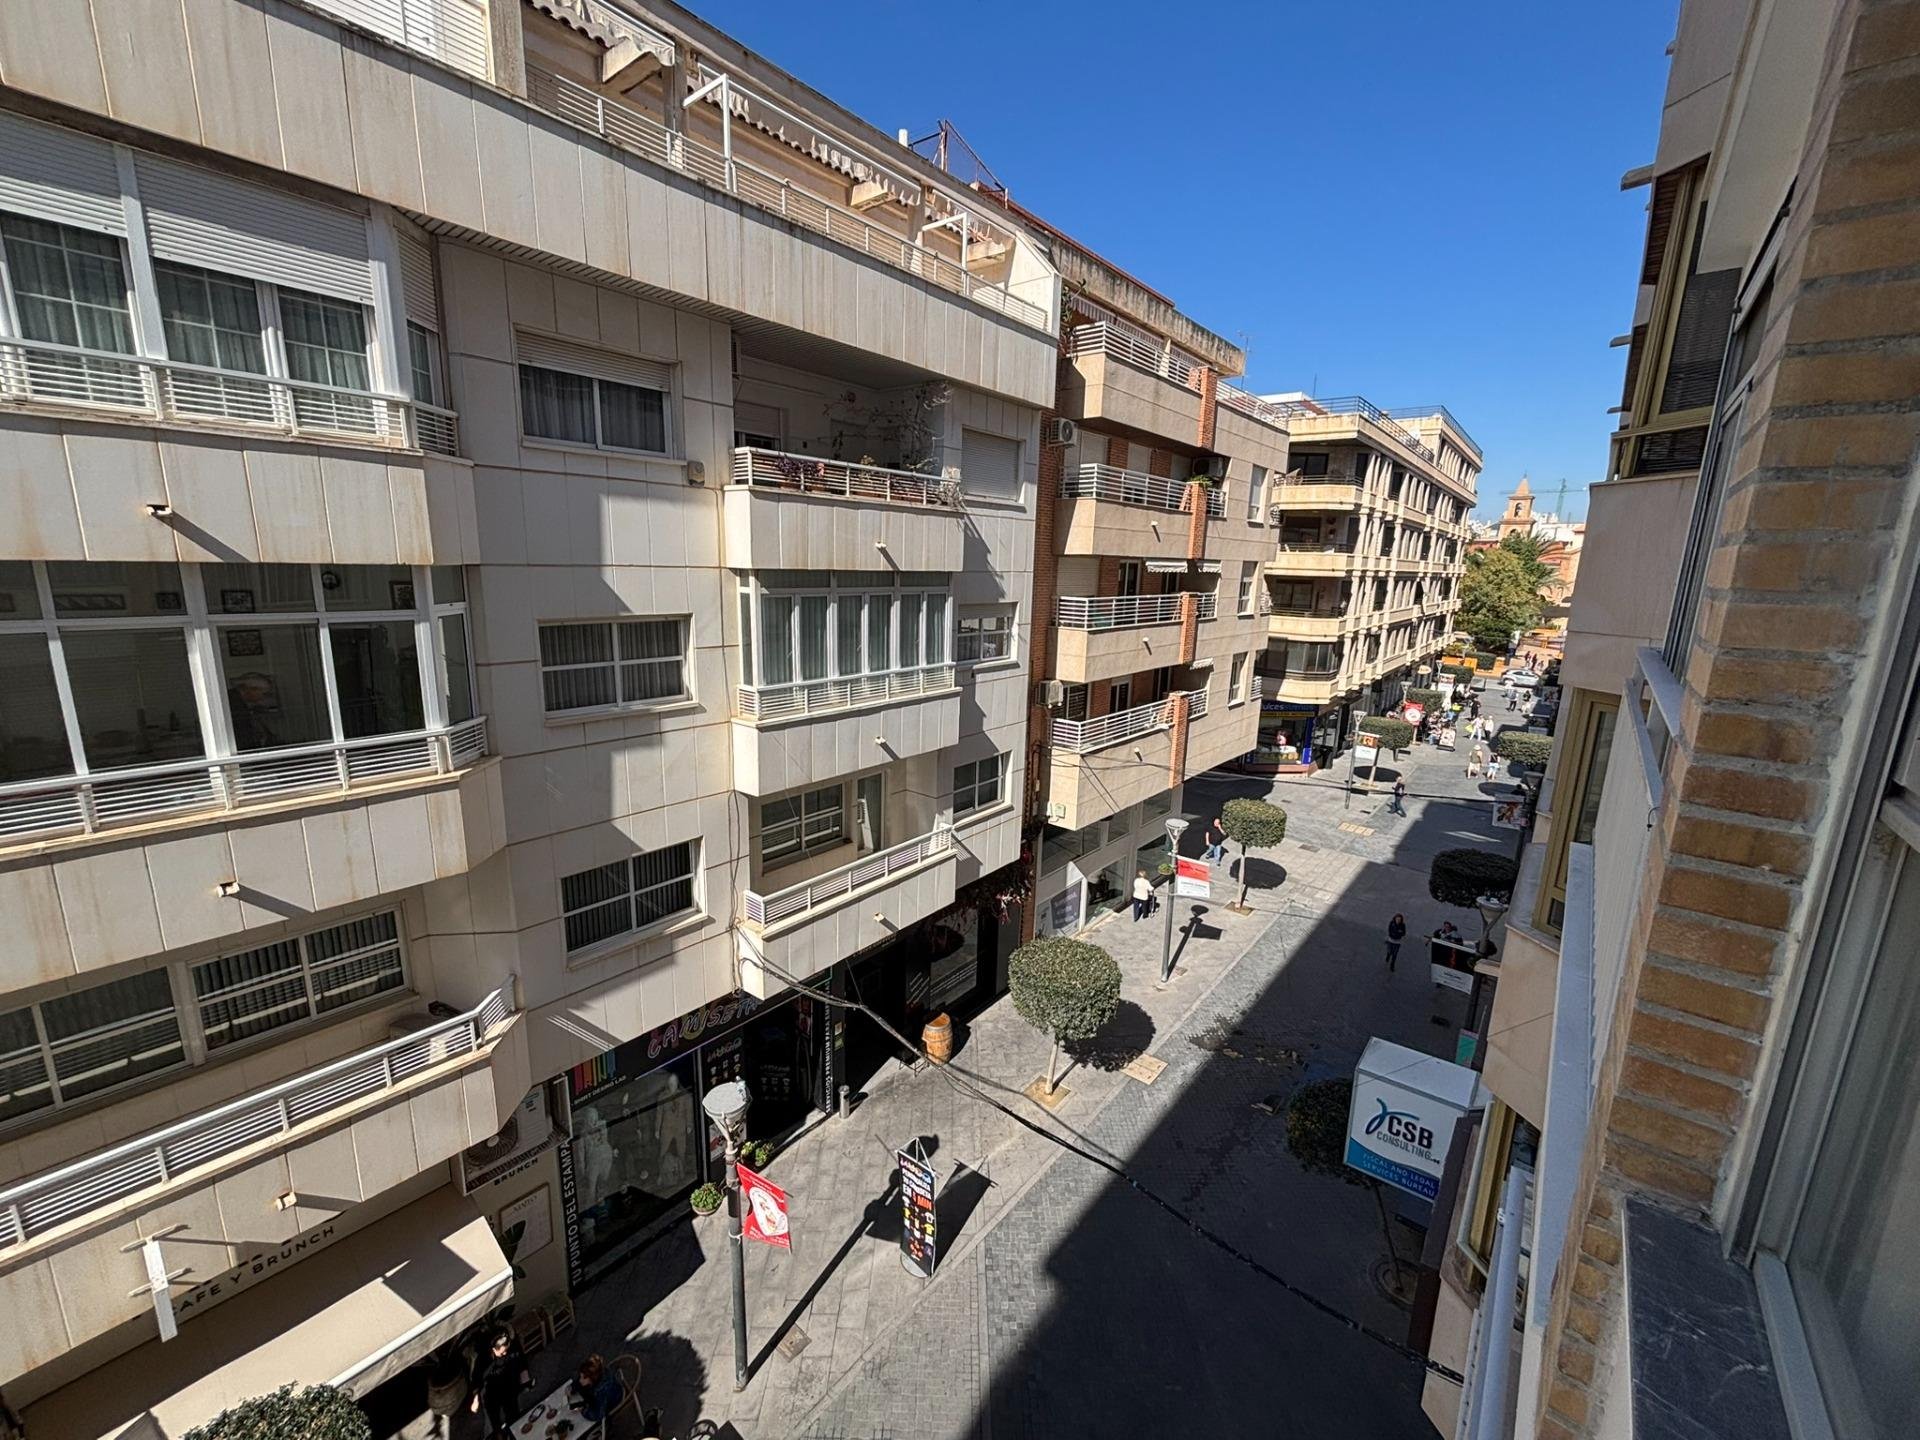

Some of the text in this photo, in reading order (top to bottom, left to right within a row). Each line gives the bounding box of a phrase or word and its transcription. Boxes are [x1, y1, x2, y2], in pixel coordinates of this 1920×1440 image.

[1376, 1131, 1432, 1160] CONSULTING
[1387, 1114, 1433, 1149] CSB
[494, 1157, 539, 1186] BRUNCH
[565, 1198, 578, 1224] DEL
[230, 1272, 243, 1284] Y
[252, 1226, 335, 1275] BRUNCH
[568, 1226, 581, 1267] PUNTO
[572, 1268, 583, 1286] TU
